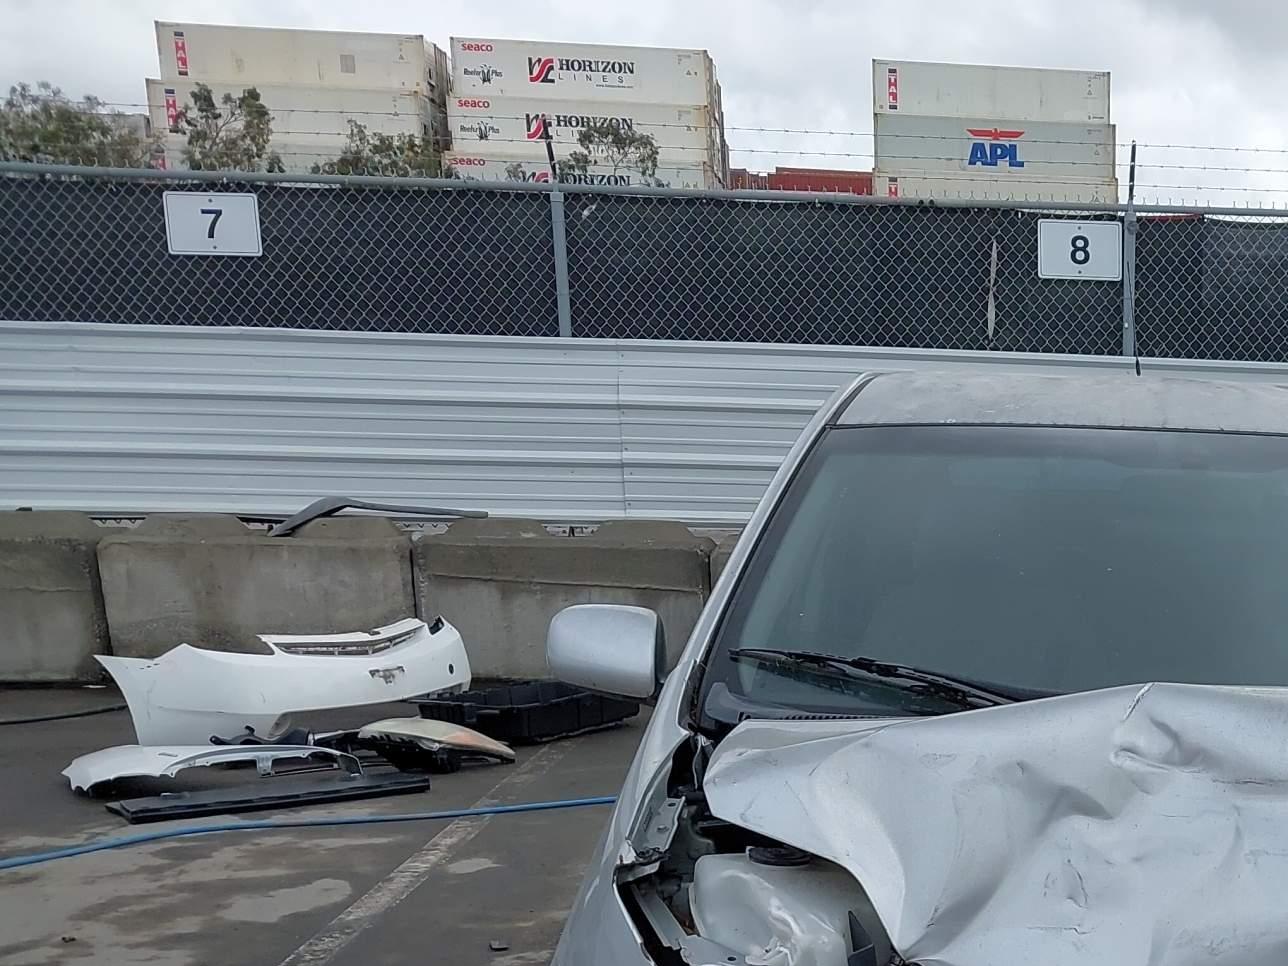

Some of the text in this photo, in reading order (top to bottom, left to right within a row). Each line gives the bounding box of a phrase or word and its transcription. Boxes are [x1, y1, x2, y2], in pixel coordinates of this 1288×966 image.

[175, 41, 188, 70] TAL
[461, 42, 493, 52] seaco
[557, 59, 635, 75] HORIZON
[558, 74, 625, 84] LINES
[889, 76, 897, 104] TAL
[457, 98, 490, 109] seaco
[556, 114, 633, 130] HORIZON
[968, 142, 1024, 168] APL
[200, 208, 223, 239] 7
[1070, 235, 1091, 265] 8
